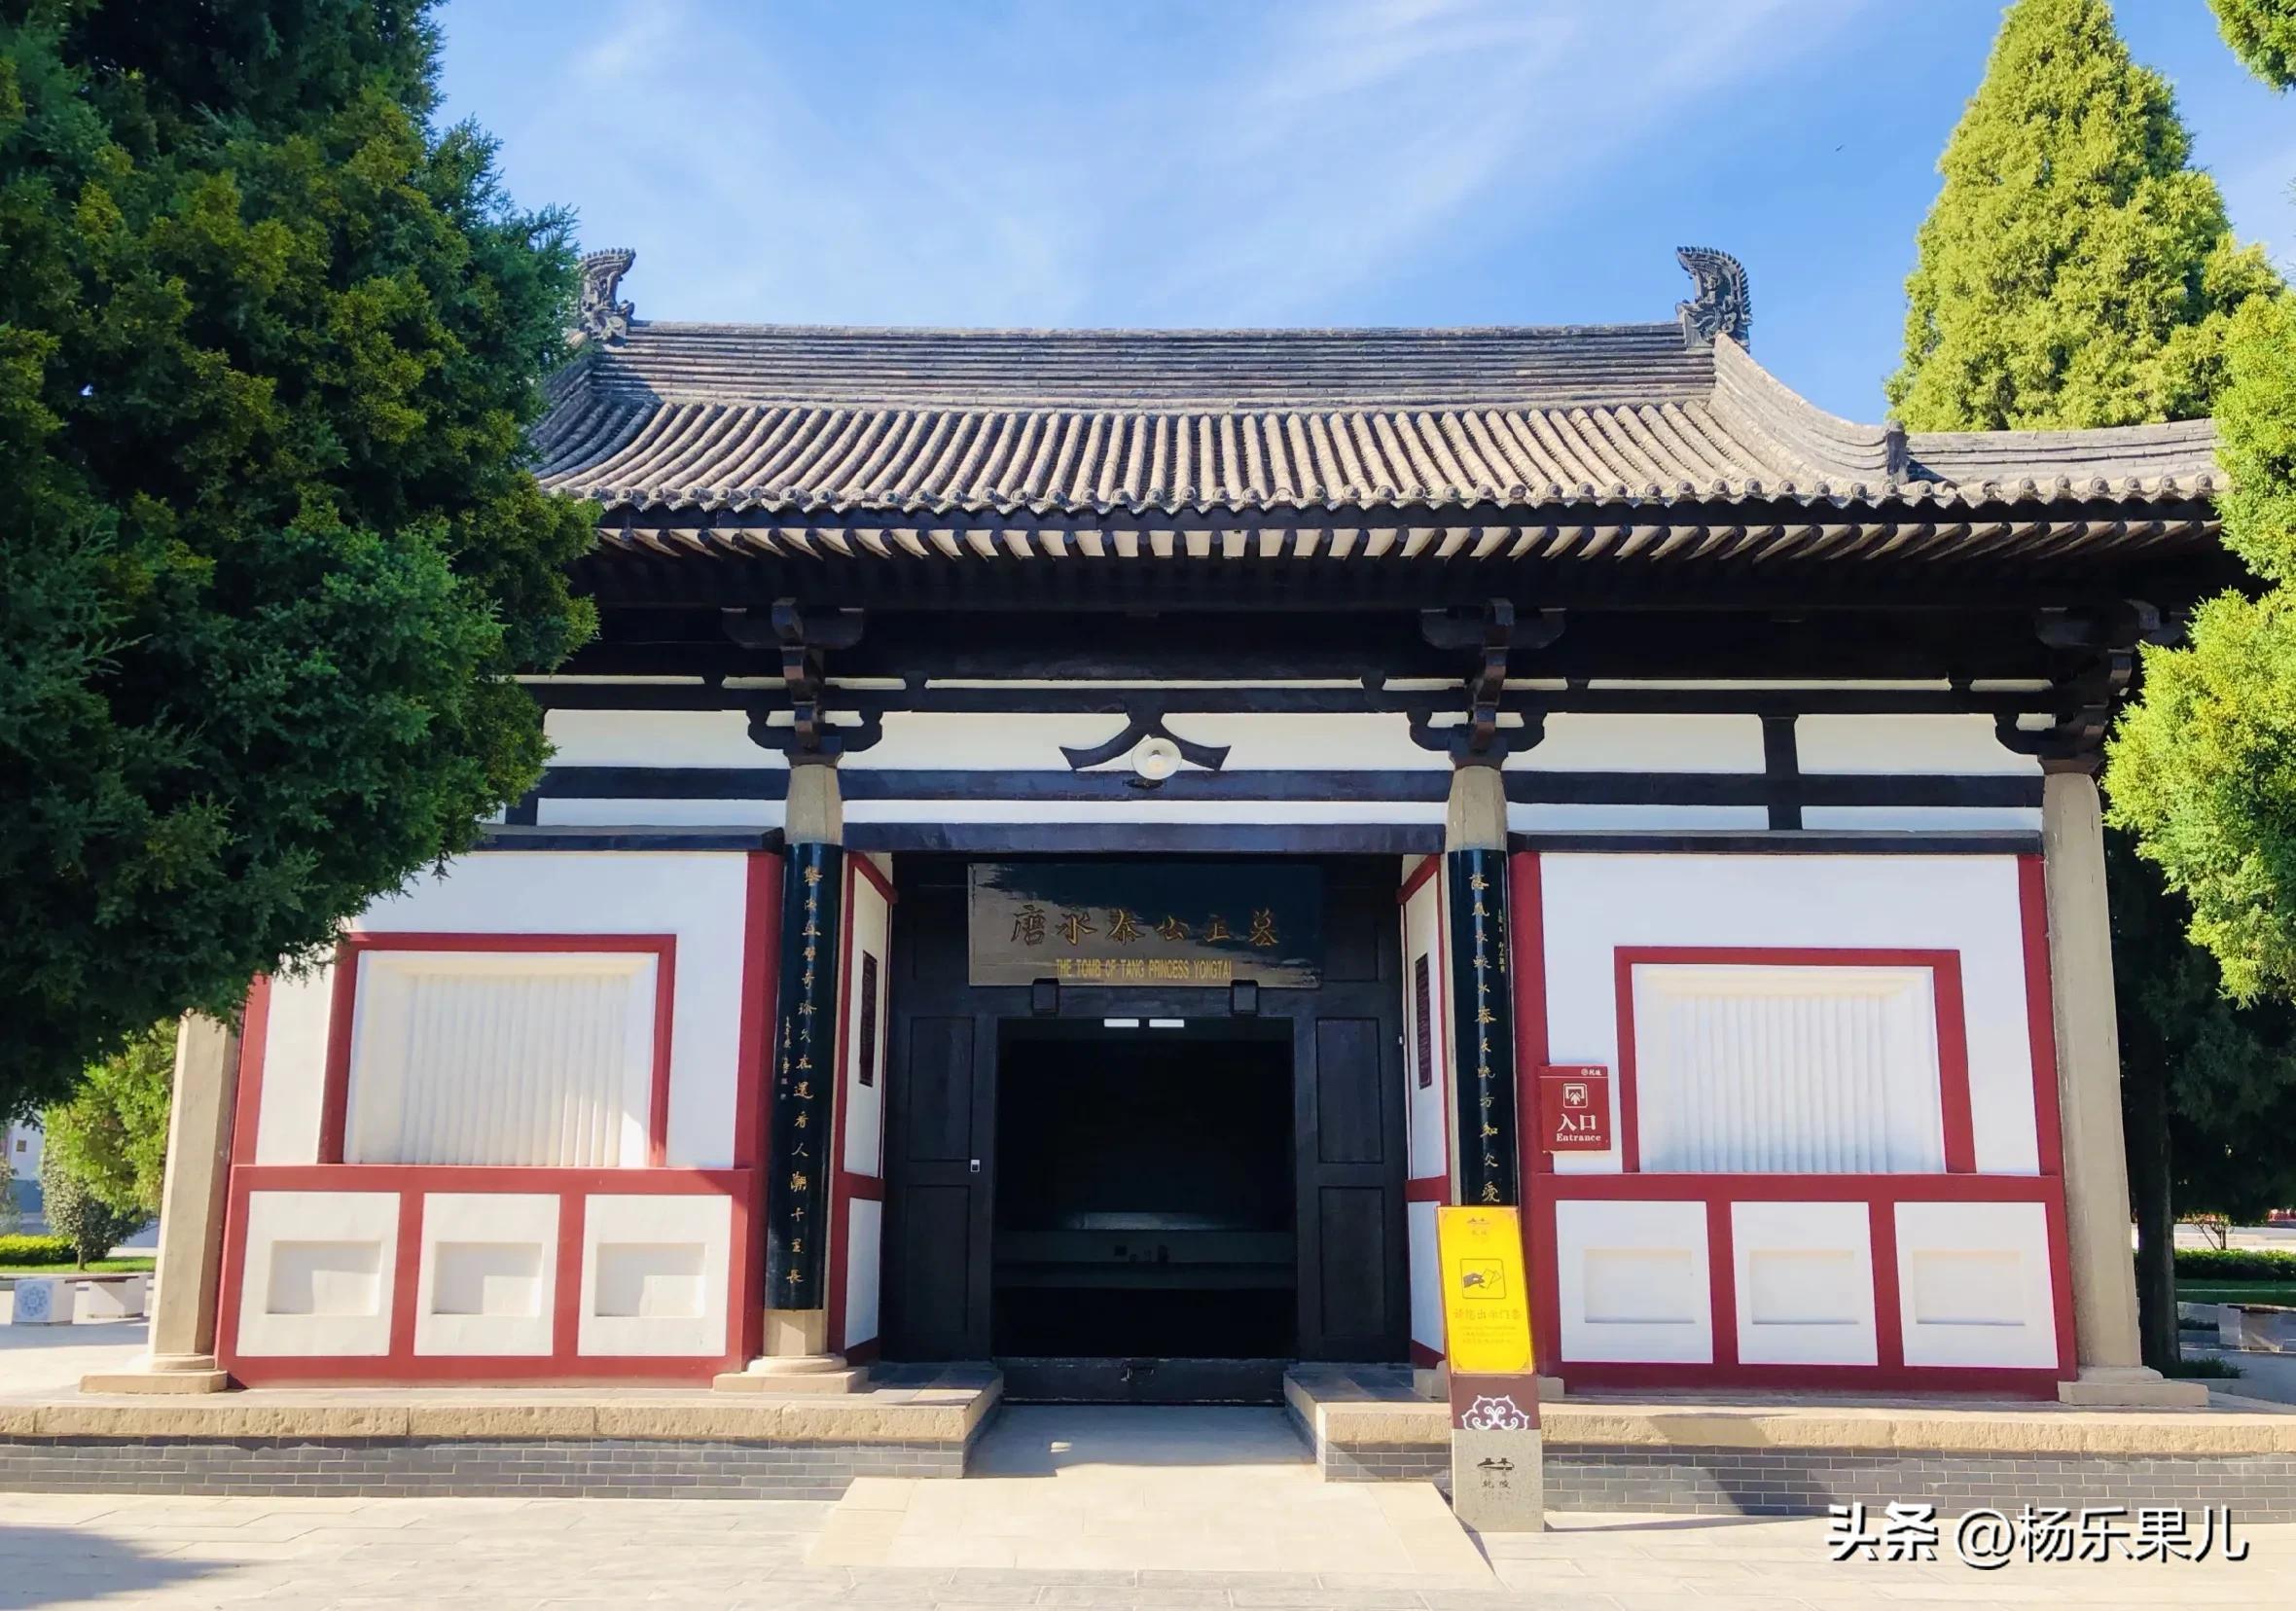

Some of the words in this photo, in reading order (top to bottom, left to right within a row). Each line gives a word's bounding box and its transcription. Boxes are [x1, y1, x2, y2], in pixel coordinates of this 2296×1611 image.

[1011, 904, 1279, 947] 唐永泰公主墓
[1057, 959, 1072, 977] THE
[1077, 959, 1101, 977] TOMB
[1105, 959, 1116, 978] OF
[1121, 959, 1144, 978] TANG
[1149, 959, 1189, 979] PRINCESS
[1194, 959, 1232, 979] YONGTAI
[1558, 1114, 1596, 1131] 入口
[1557, 1133, 1601, 1142] Entrance
